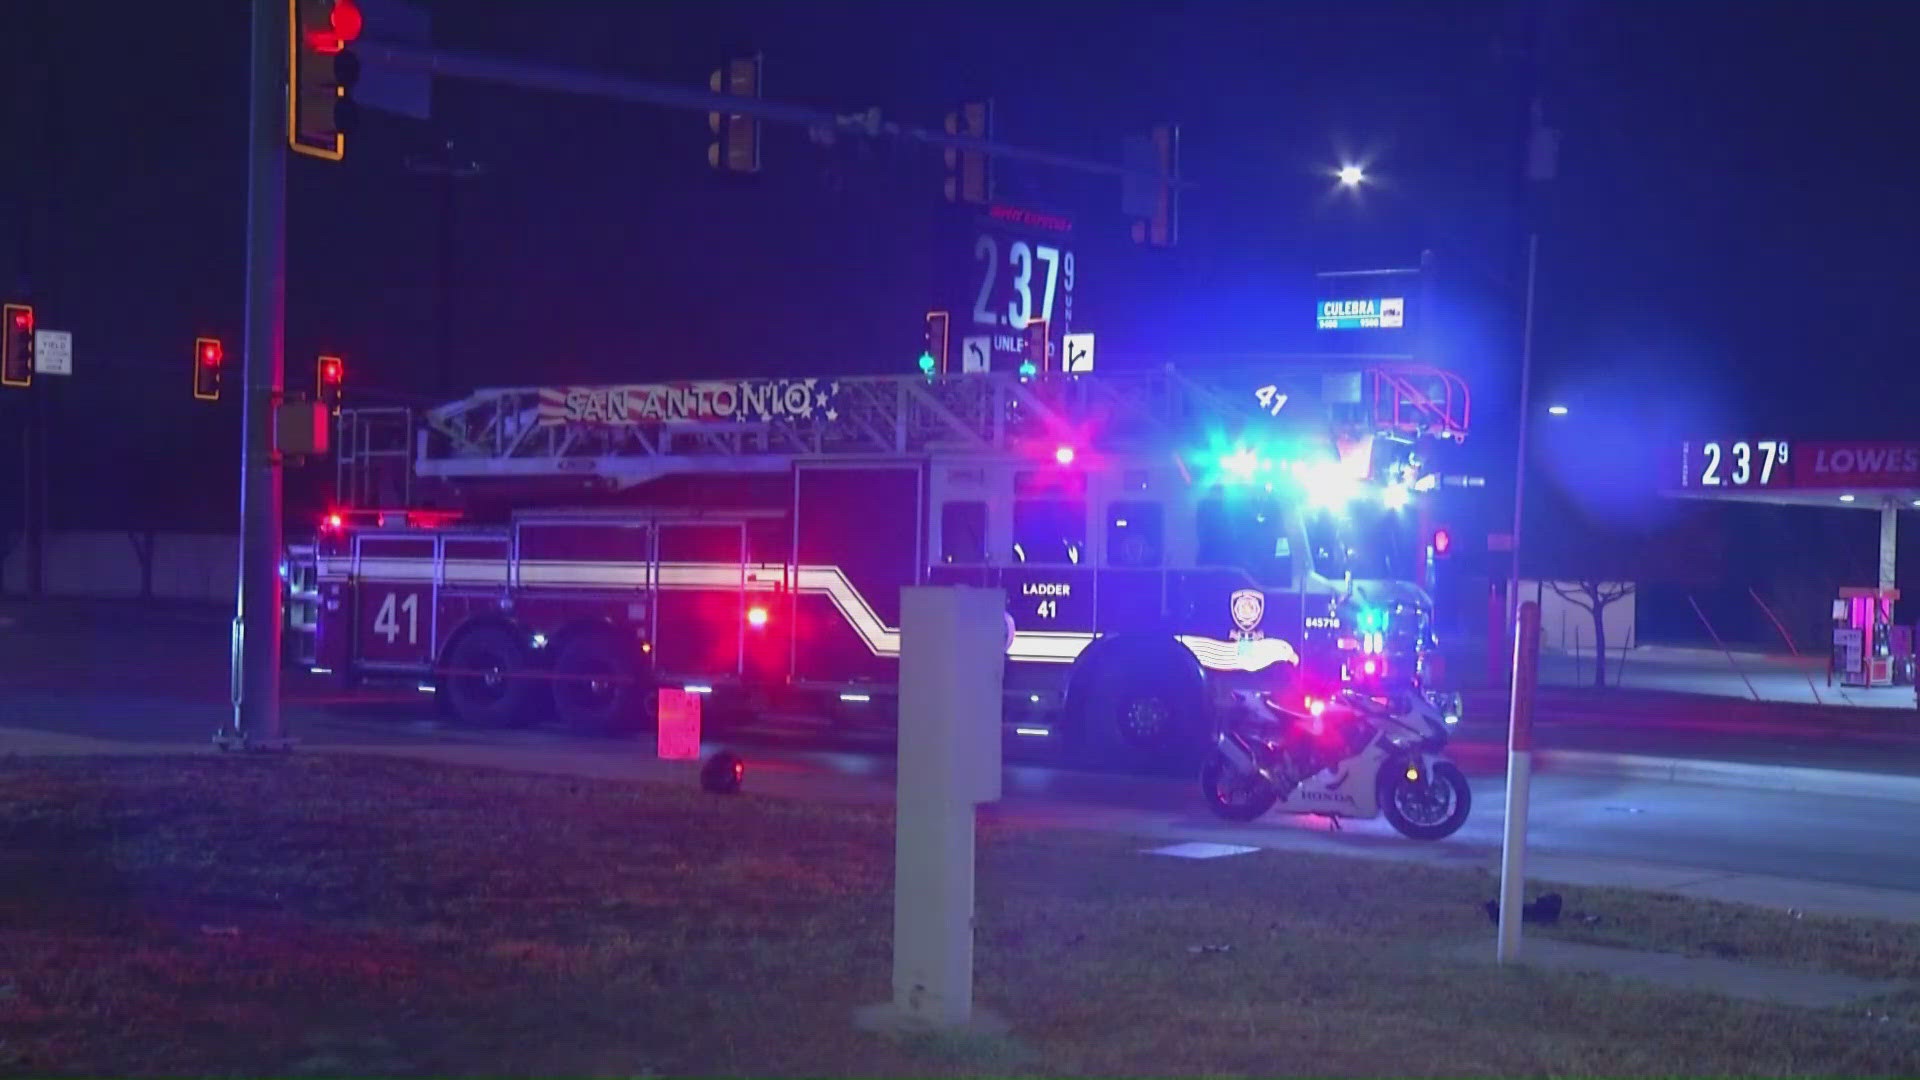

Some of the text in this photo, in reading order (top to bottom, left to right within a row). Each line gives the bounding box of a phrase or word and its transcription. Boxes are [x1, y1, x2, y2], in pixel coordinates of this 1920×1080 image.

[1323, 299, 1375, 316] CULEBRA
[565, 381, 812, 421] SAN ANTONIO
[1255, 385, 1288, 416] 41
[1022, 583, 1071, 596] LADDER
[374, 592, 418, 644] 41
[1037, 600, 1056, 618] 41
[1301, 790, 1355, 807] HONDA
